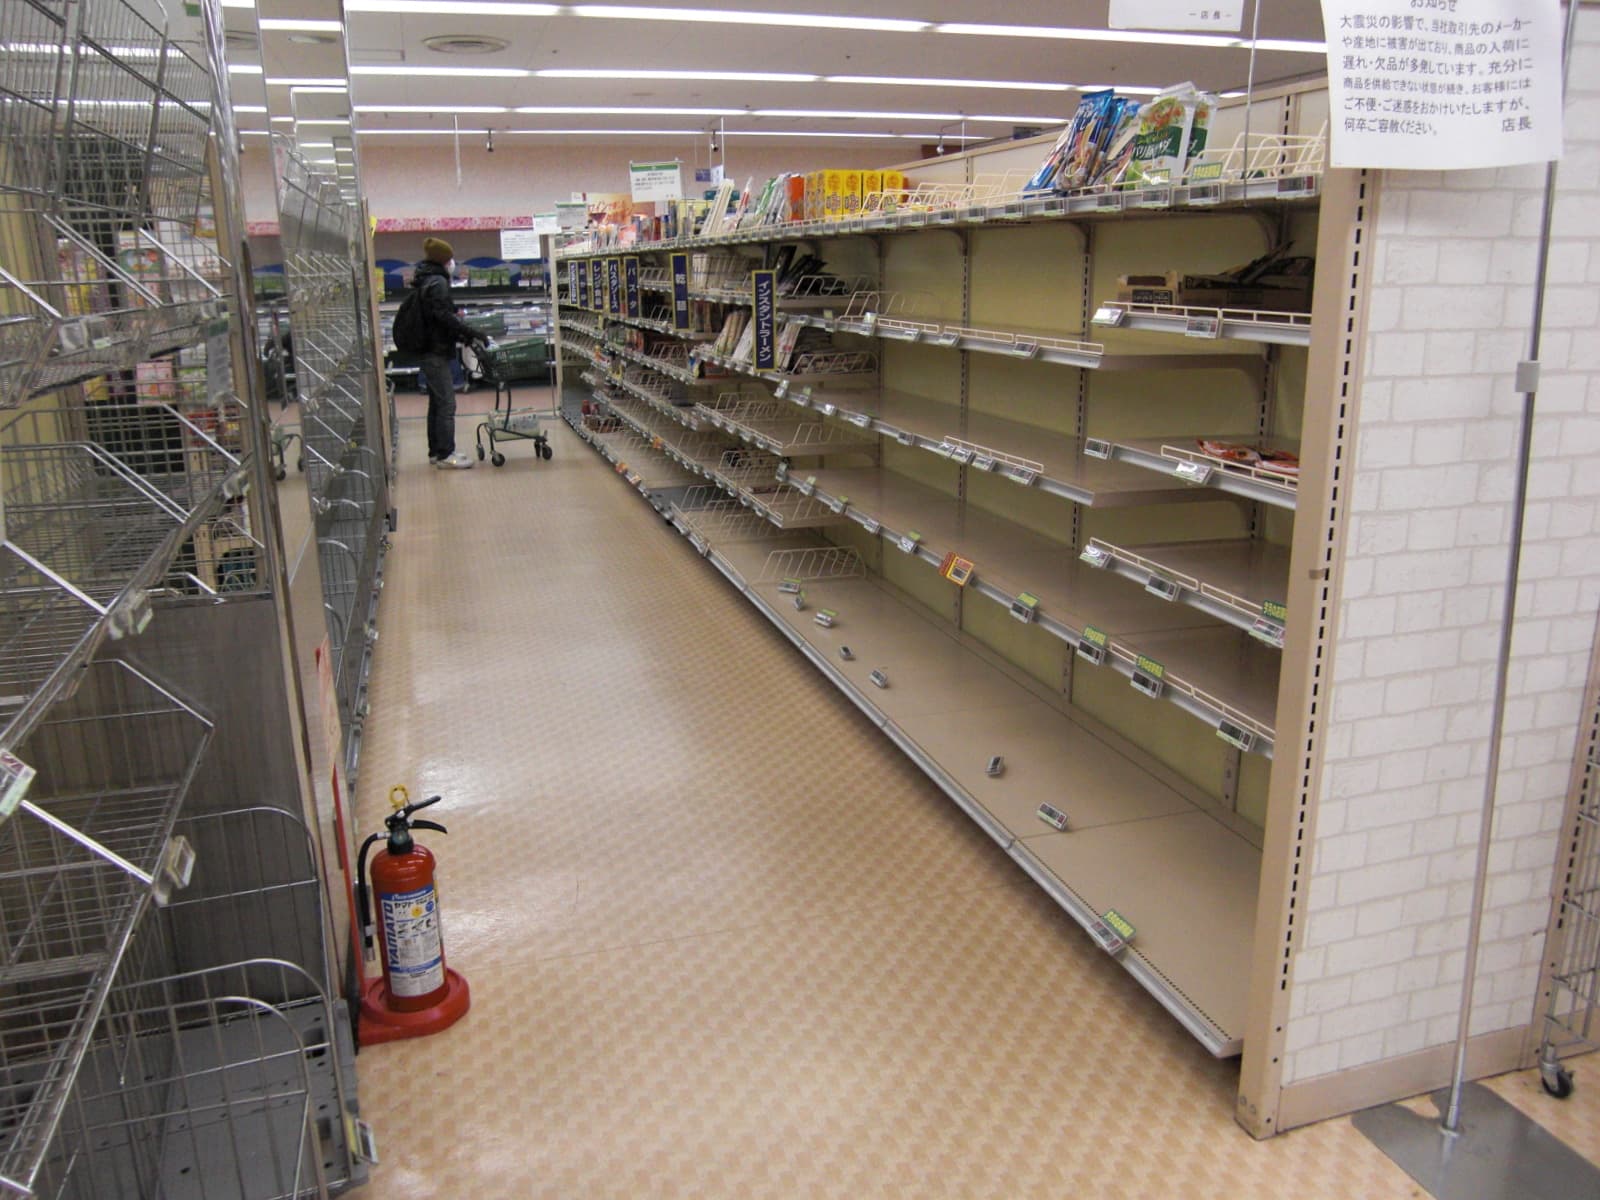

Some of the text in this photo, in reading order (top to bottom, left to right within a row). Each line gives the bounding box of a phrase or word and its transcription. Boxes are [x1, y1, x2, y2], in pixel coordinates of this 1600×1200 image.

[1502, 116, 1532, 132] 店長
[609, 263, 618, 309] パスタソース
[627, 267, 637, 309] パスタ
[758, 280, 771, 362] インスタントラーメン
[384, 902, 399, 965] YAMATO
